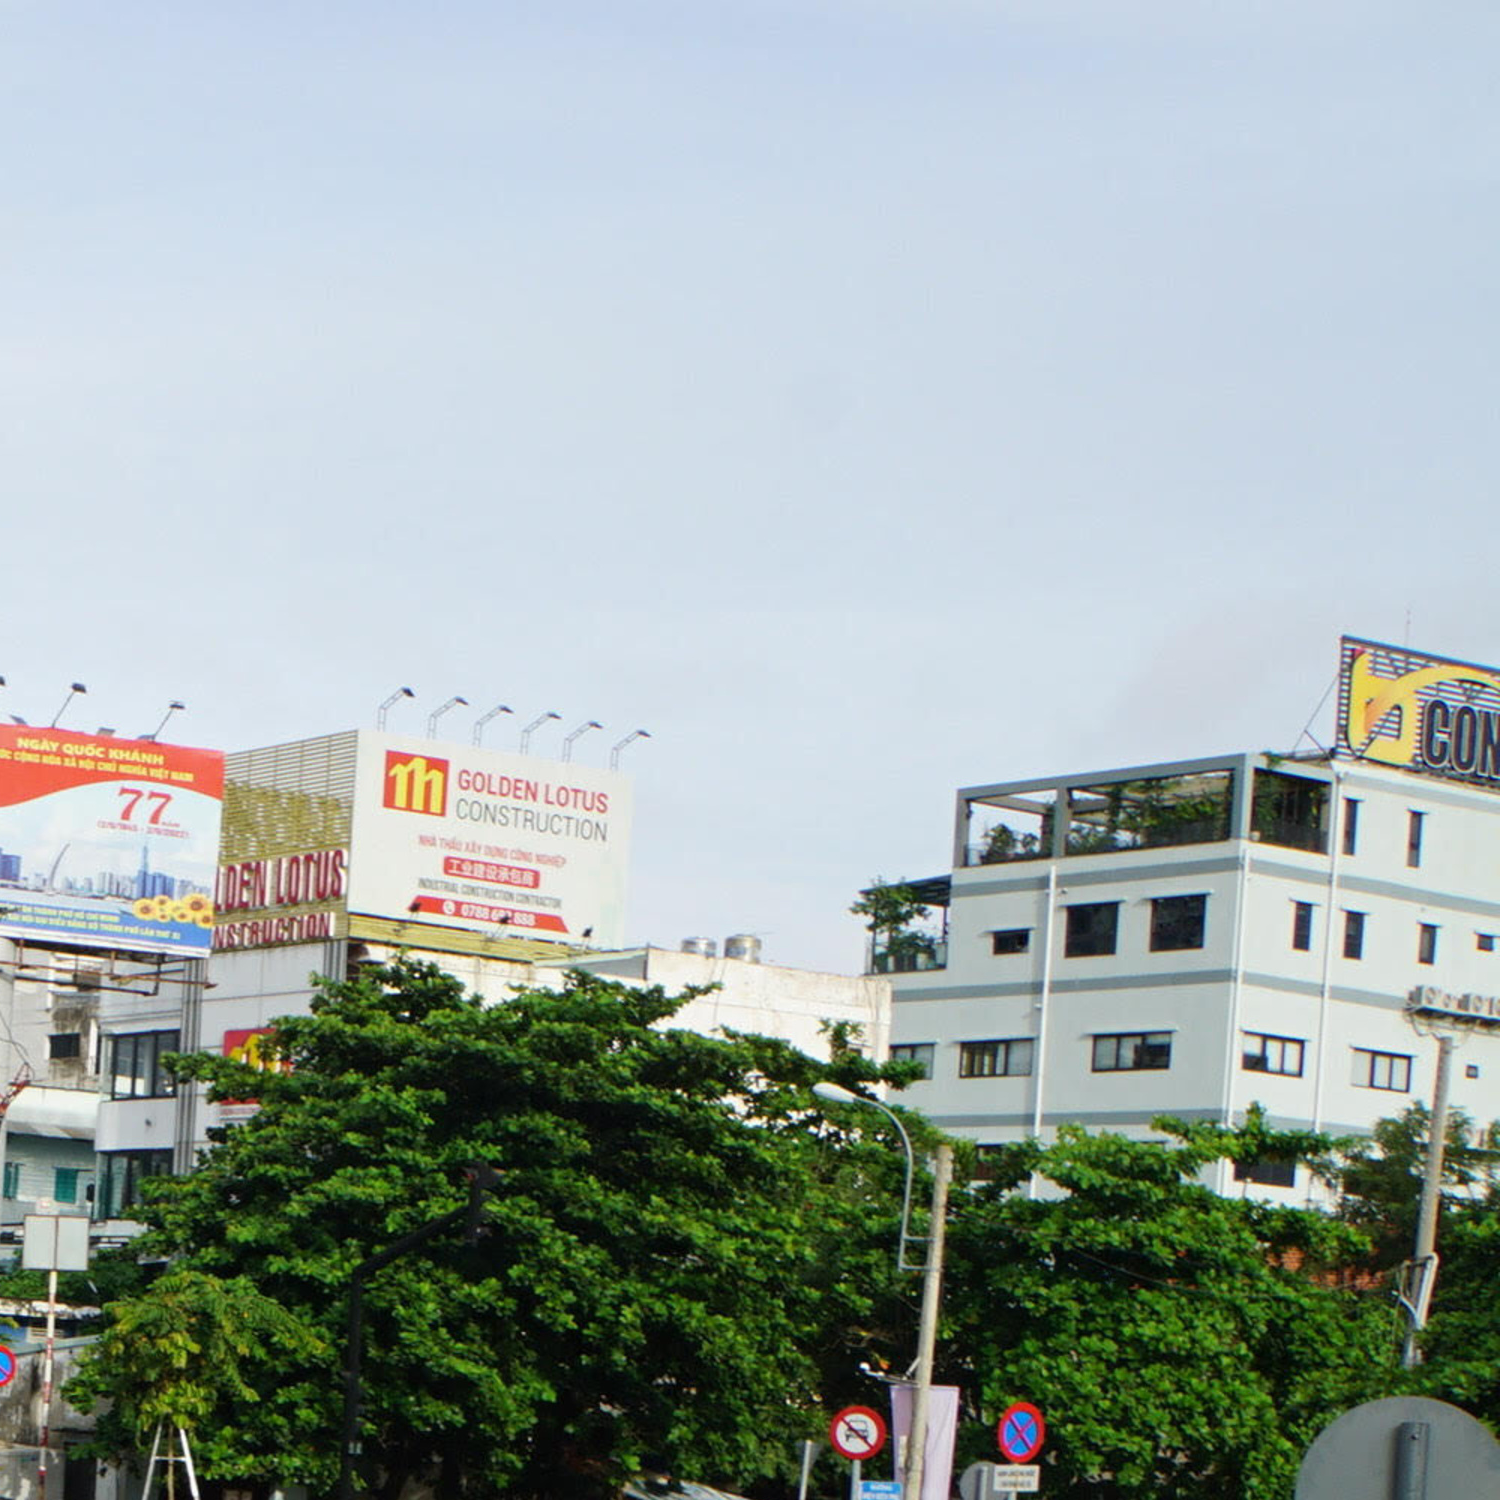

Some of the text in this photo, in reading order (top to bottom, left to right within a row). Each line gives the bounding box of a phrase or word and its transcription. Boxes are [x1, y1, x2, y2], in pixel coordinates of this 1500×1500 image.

[17, 737, 165, 766] NGÀY QUỐC KHÁNH
[118, 786, 173, 825] 77
[457, 769, 609, 813] GOLDEN LOTUS
[456, 797, 608, 842] CONSTRUCTION
[276, 849, 345, 905] LOTUS
